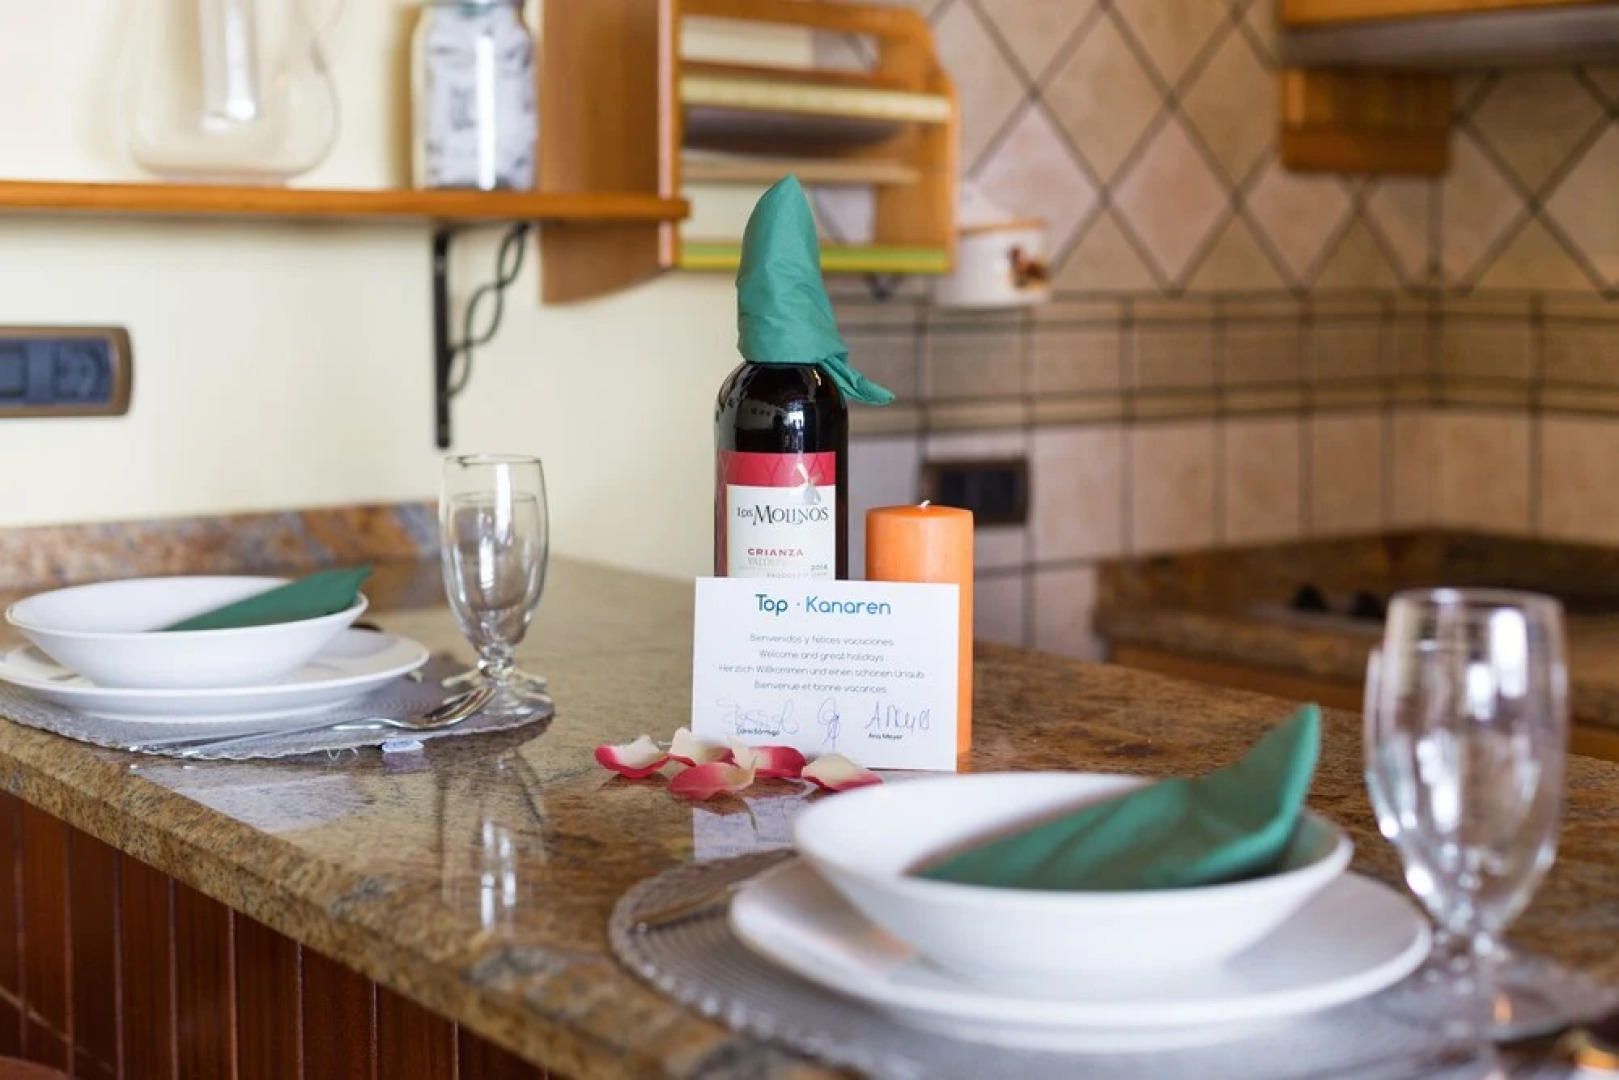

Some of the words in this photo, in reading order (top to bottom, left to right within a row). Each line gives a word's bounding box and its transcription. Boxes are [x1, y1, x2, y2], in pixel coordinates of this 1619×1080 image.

[747, 548, 804, 557] CRIANZA
[755, 593, 789, 616] Top
[805, 595, 892, 616] Kanaren
[749, 633, 802, 644] Bienvenidos
[811, 635, 841, 645] felices
[842, 638, 894, 647] vacaciones
[759, 649, 799, 660] Welcome
[801, 651, 819, 661] and
[820, 652, 845, 663] great
[846, 652, 885, 663] holidays
[718, 664, 754, 674] Herzlich
[756, 665, 809, 676] Willkommen
[810, 667, 828, 676] und
[828, 668, 853, 677] einen
[894, 670, 925, 679] Urlaub
[754, 680, 800, 691] Bienvenue
[801, 683, 812, 692] et
[813, 682, 843, 692] bonne
[844, 685, 888, 694] vacances
